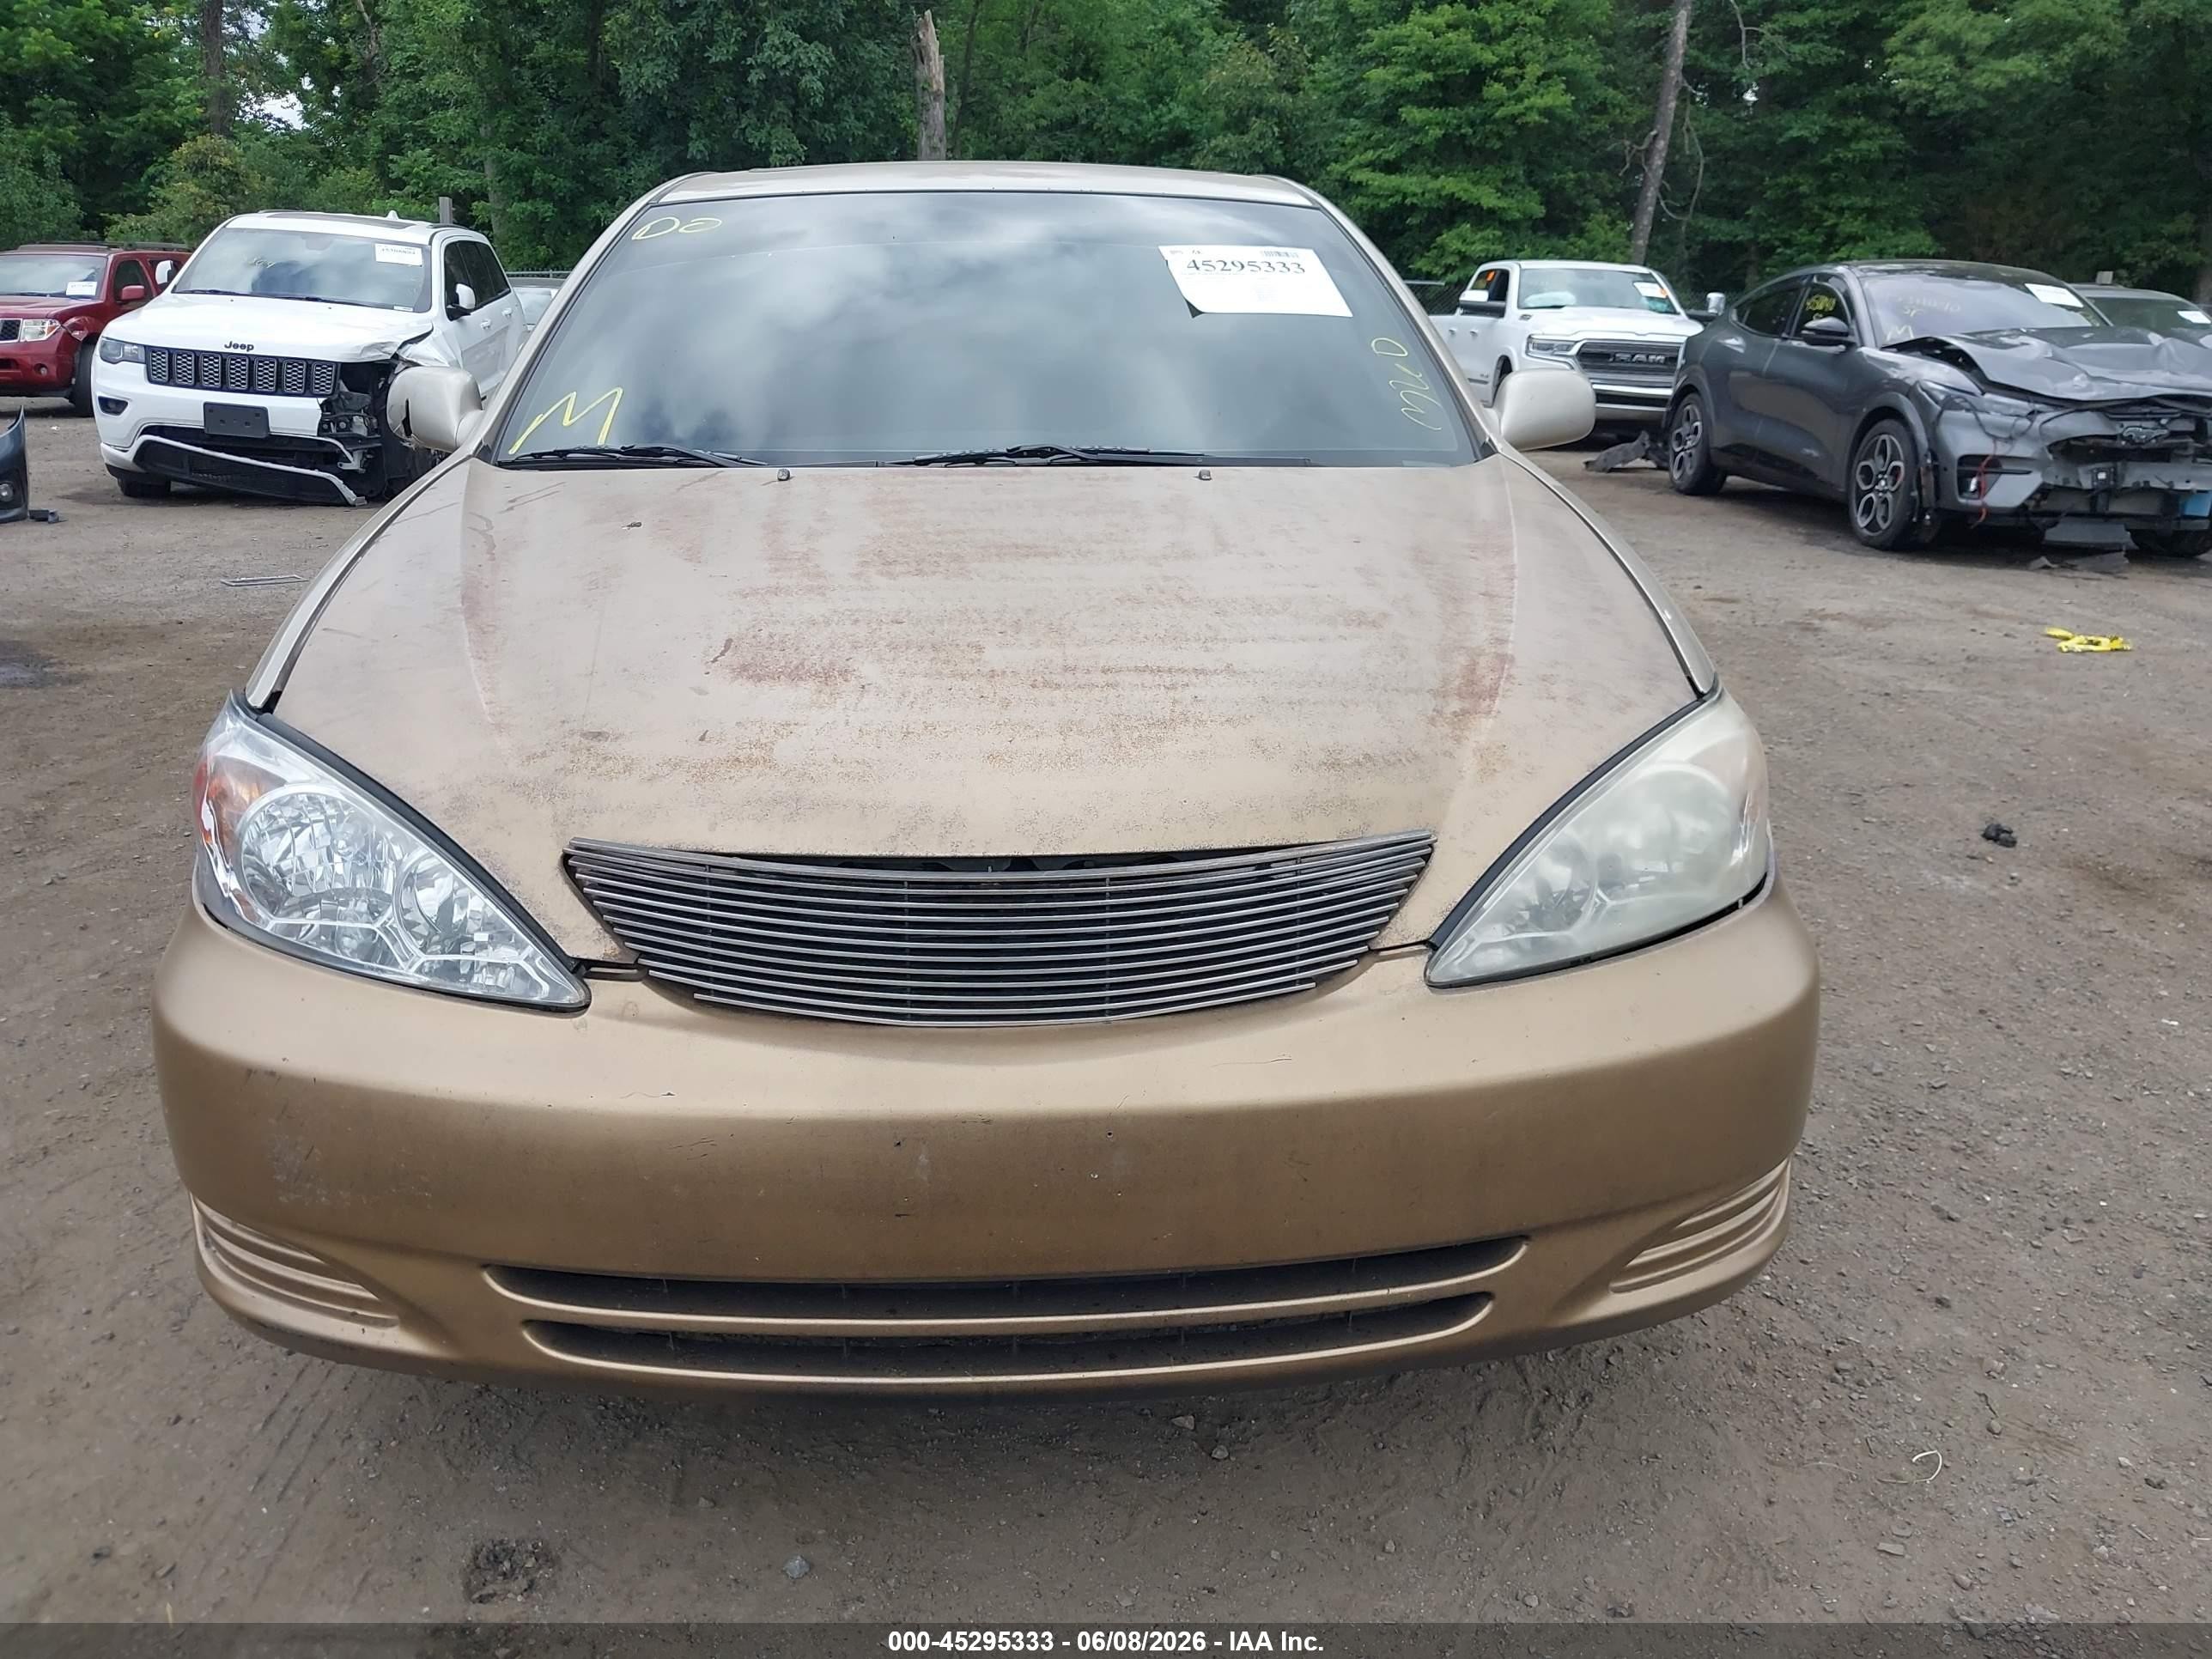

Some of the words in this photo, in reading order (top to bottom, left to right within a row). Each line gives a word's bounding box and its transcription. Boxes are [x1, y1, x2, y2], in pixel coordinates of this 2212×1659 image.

[1187, 258, 1306, 274] 45295333
[223, 340, 255, 352] Jeep
[1611, 352, 1667, 364] RAM
[509, 386, 623, 454] M
